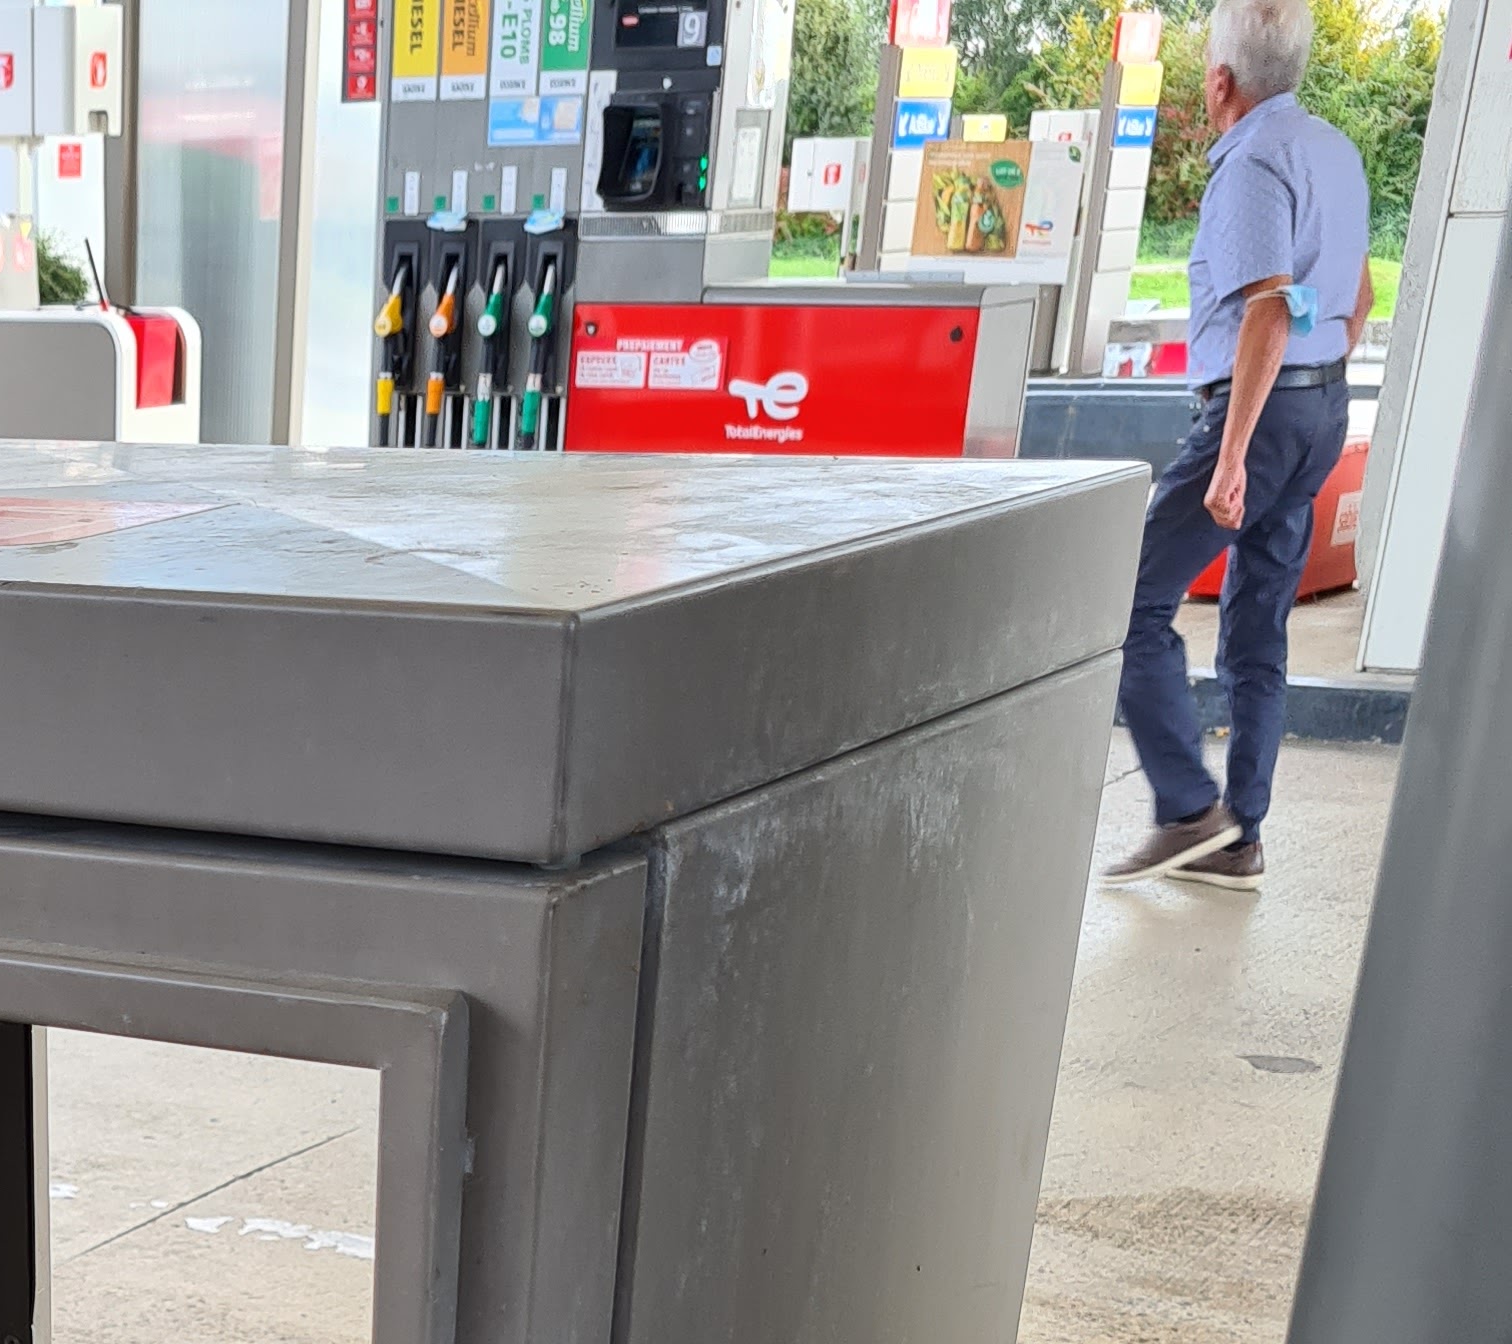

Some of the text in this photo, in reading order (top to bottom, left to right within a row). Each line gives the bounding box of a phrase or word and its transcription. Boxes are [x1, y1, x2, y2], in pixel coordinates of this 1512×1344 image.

[409, 0, 424, 54] IESEL
[452, 0, 466, 52] IESEL
[500, 1, 519, 60] -E10
[519, 9, 532, 65] PLOMB
[683, 13, 701, 44] 9
[724, 423, 804, 444] TotalEnergies
